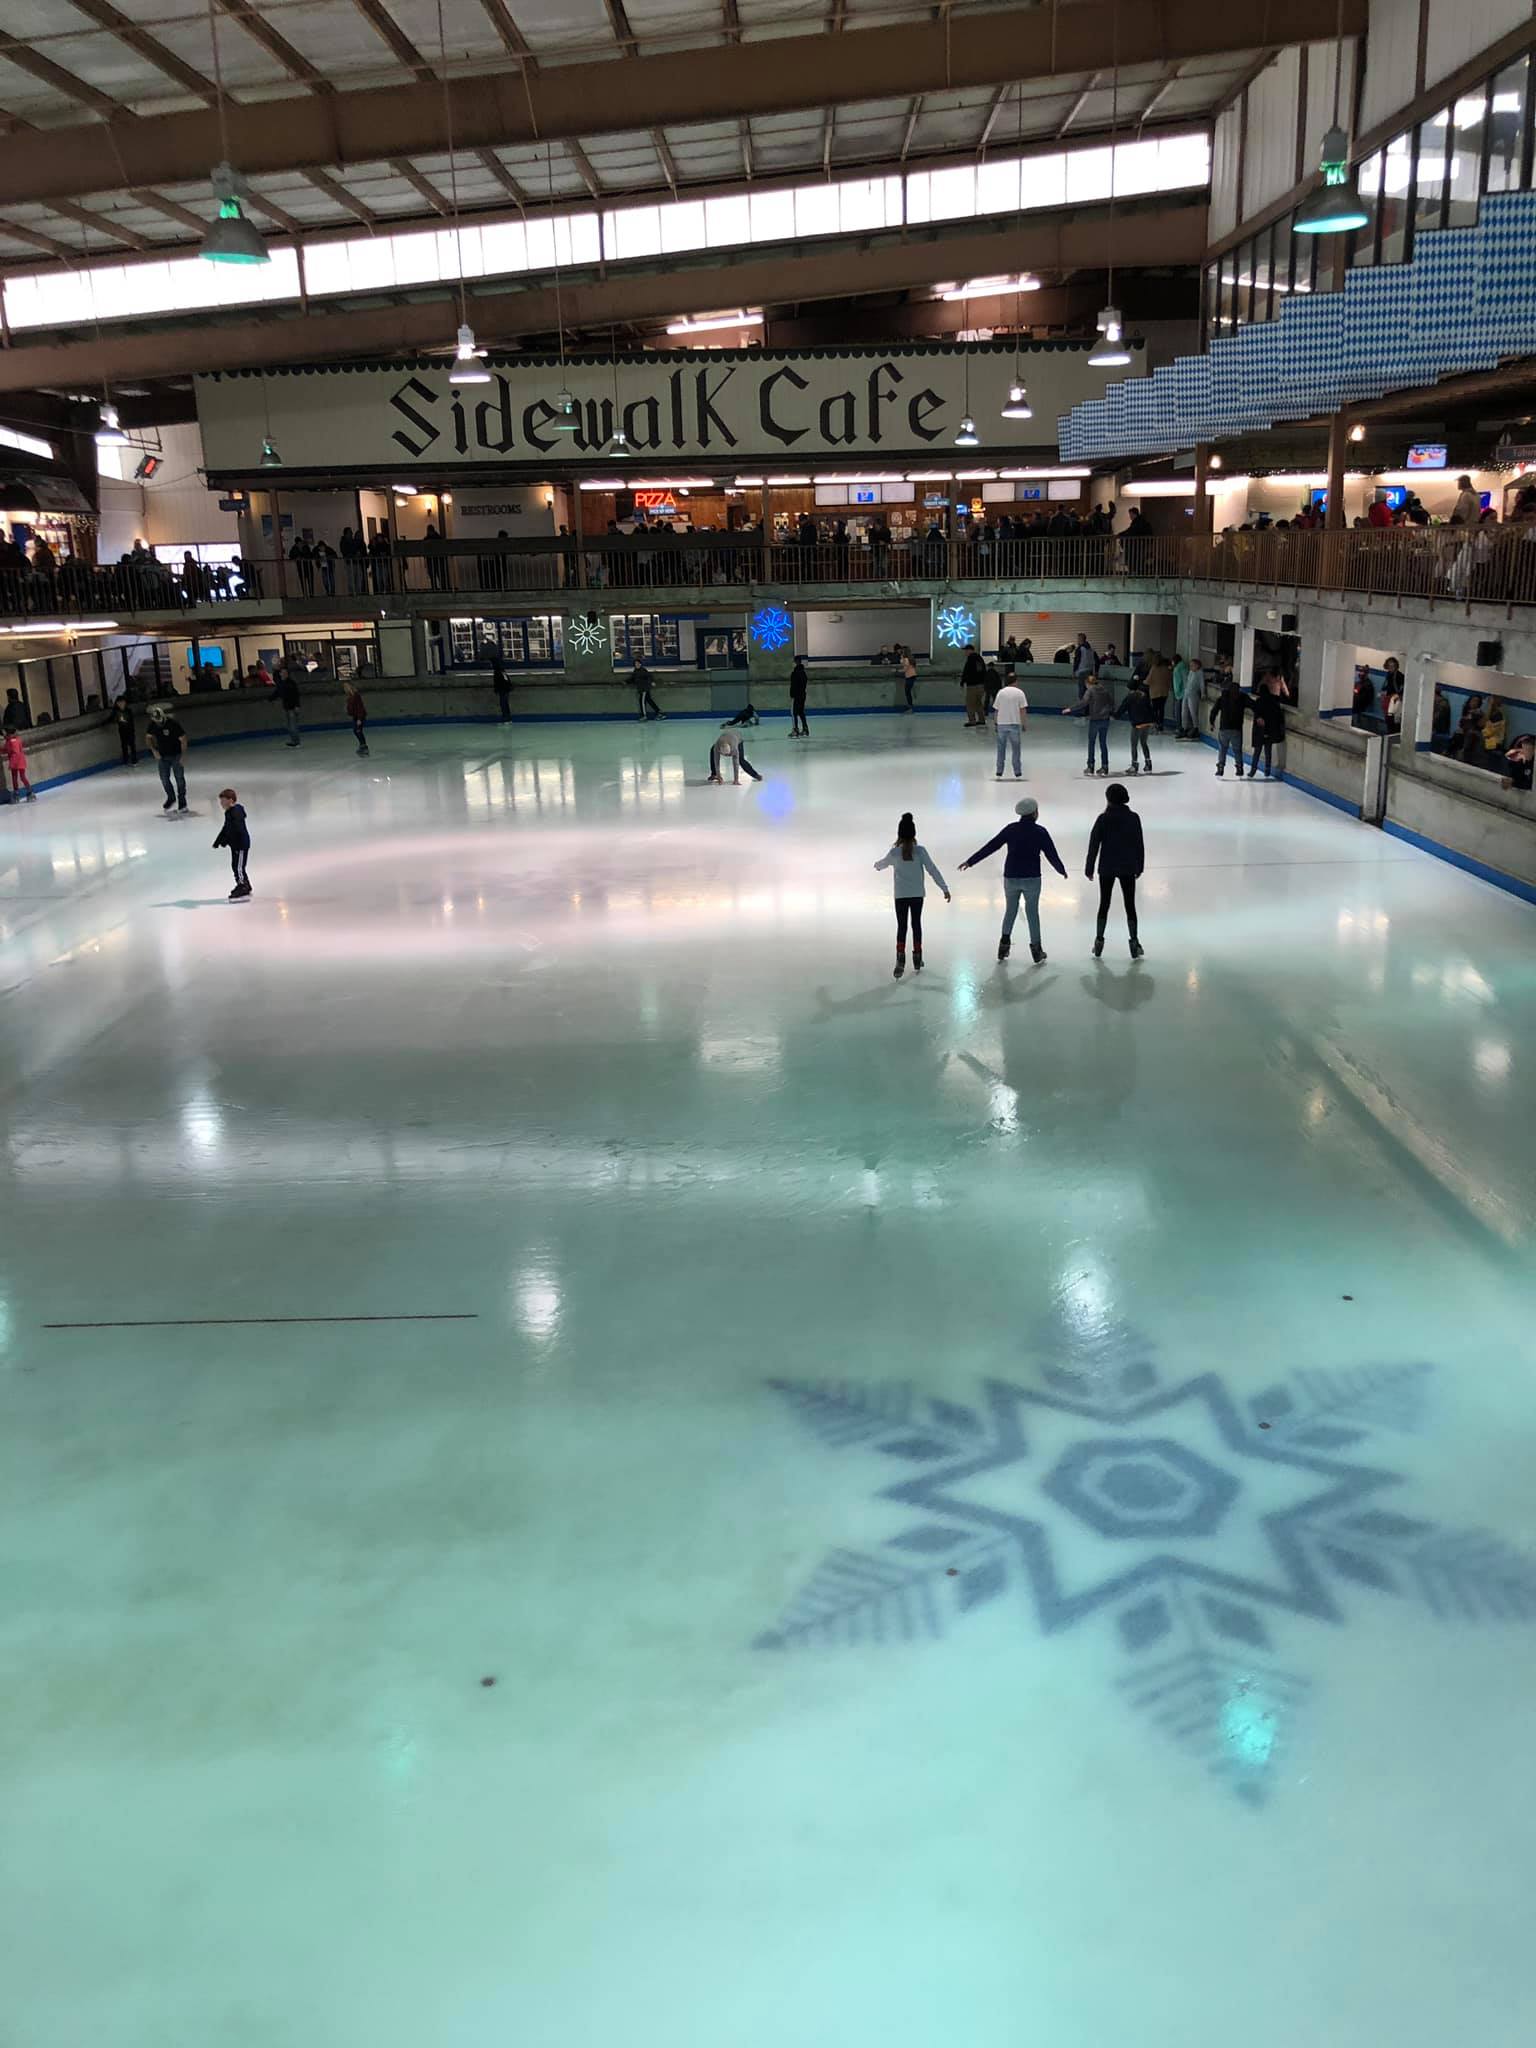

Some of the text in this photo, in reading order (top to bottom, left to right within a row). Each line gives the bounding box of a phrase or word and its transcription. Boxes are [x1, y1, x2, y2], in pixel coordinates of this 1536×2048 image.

[759, 361, 947, 446] Cafe
[635, 492, 677, 508] PIZZA
[460, 504, 523, 516] RESTROOMS
